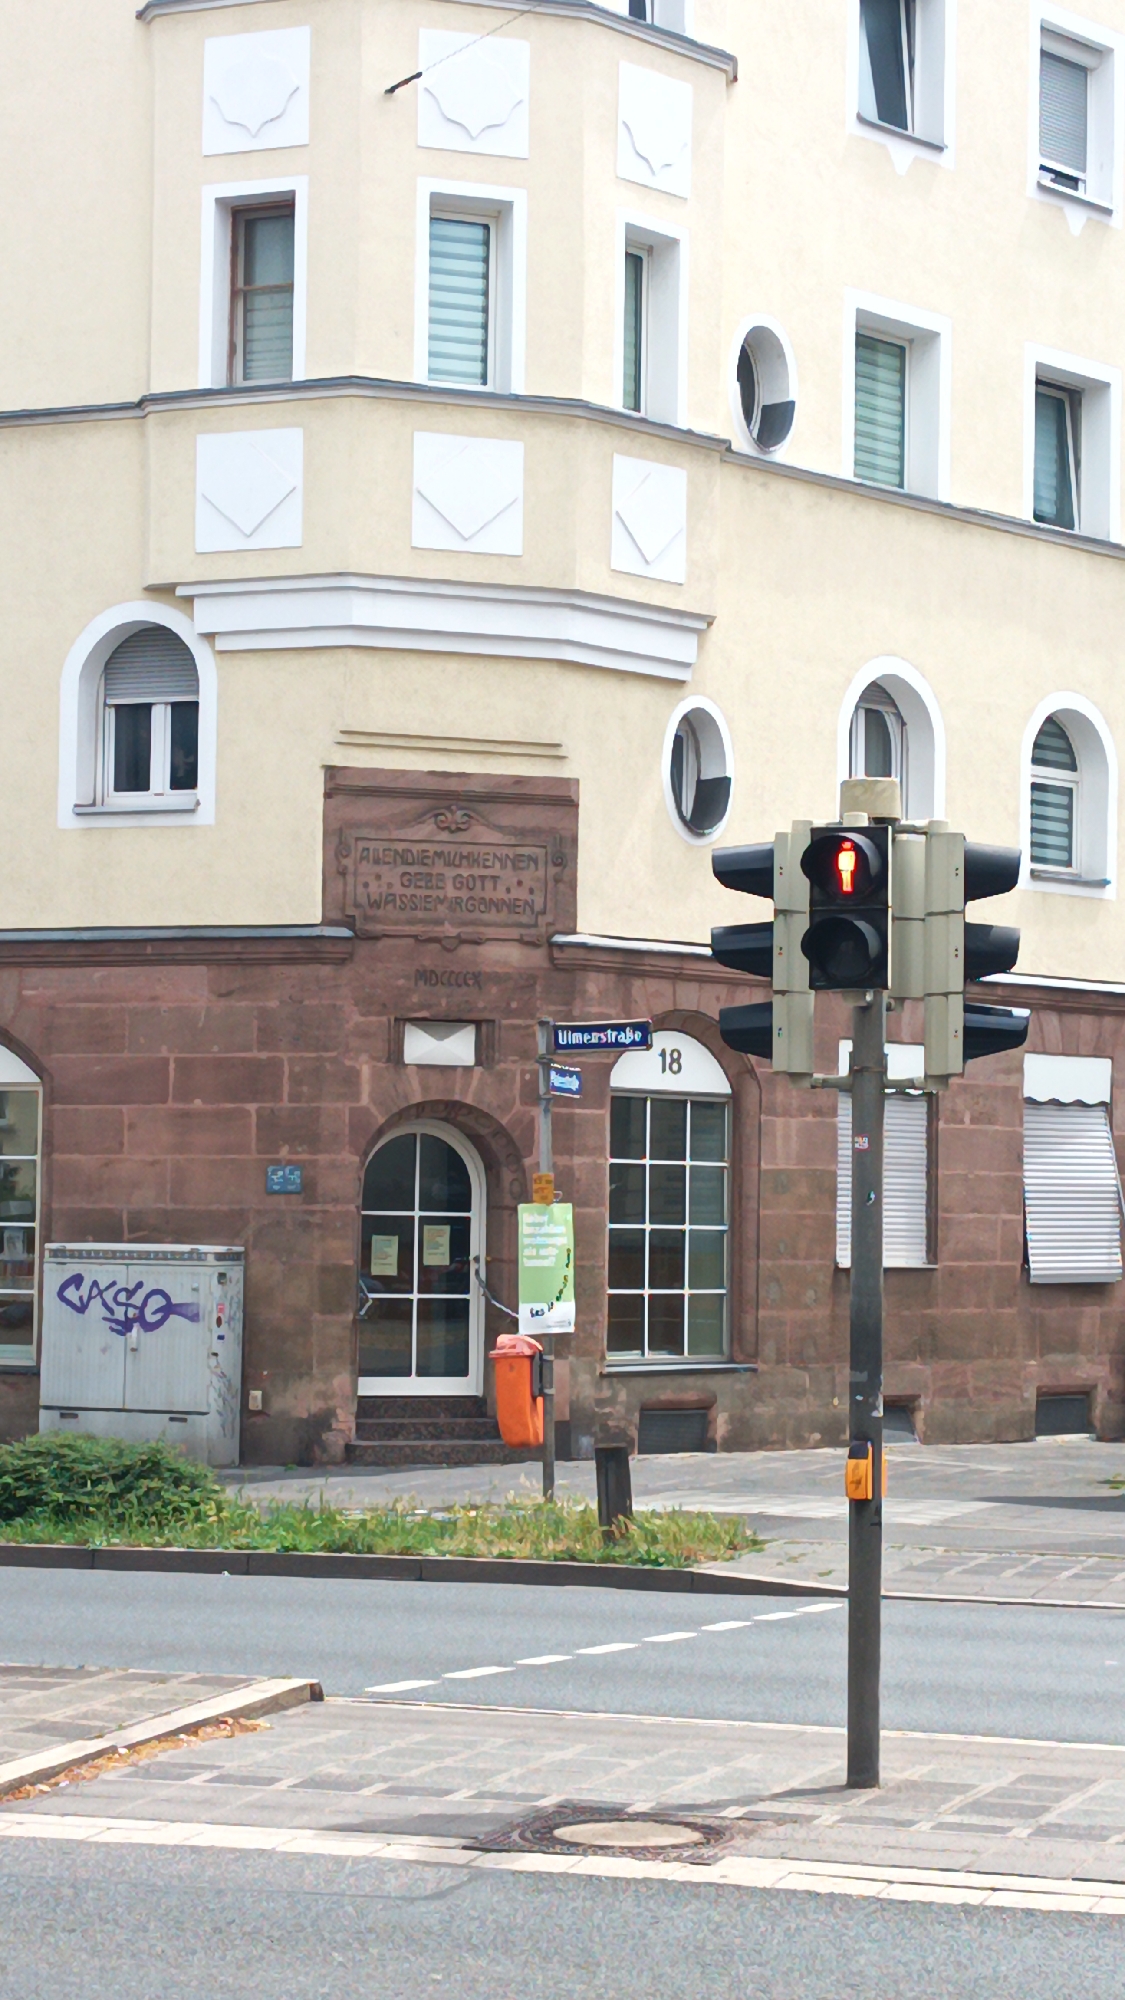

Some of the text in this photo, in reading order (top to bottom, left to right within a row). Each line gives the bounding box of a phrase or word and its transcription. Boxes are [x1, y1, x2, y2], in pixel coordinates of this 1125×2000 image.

[453, 873, 501, 892] GOTT
[557, 1026, 642, 1045] Ulmenstraße
[658, 1048, 682, 1075] 18
